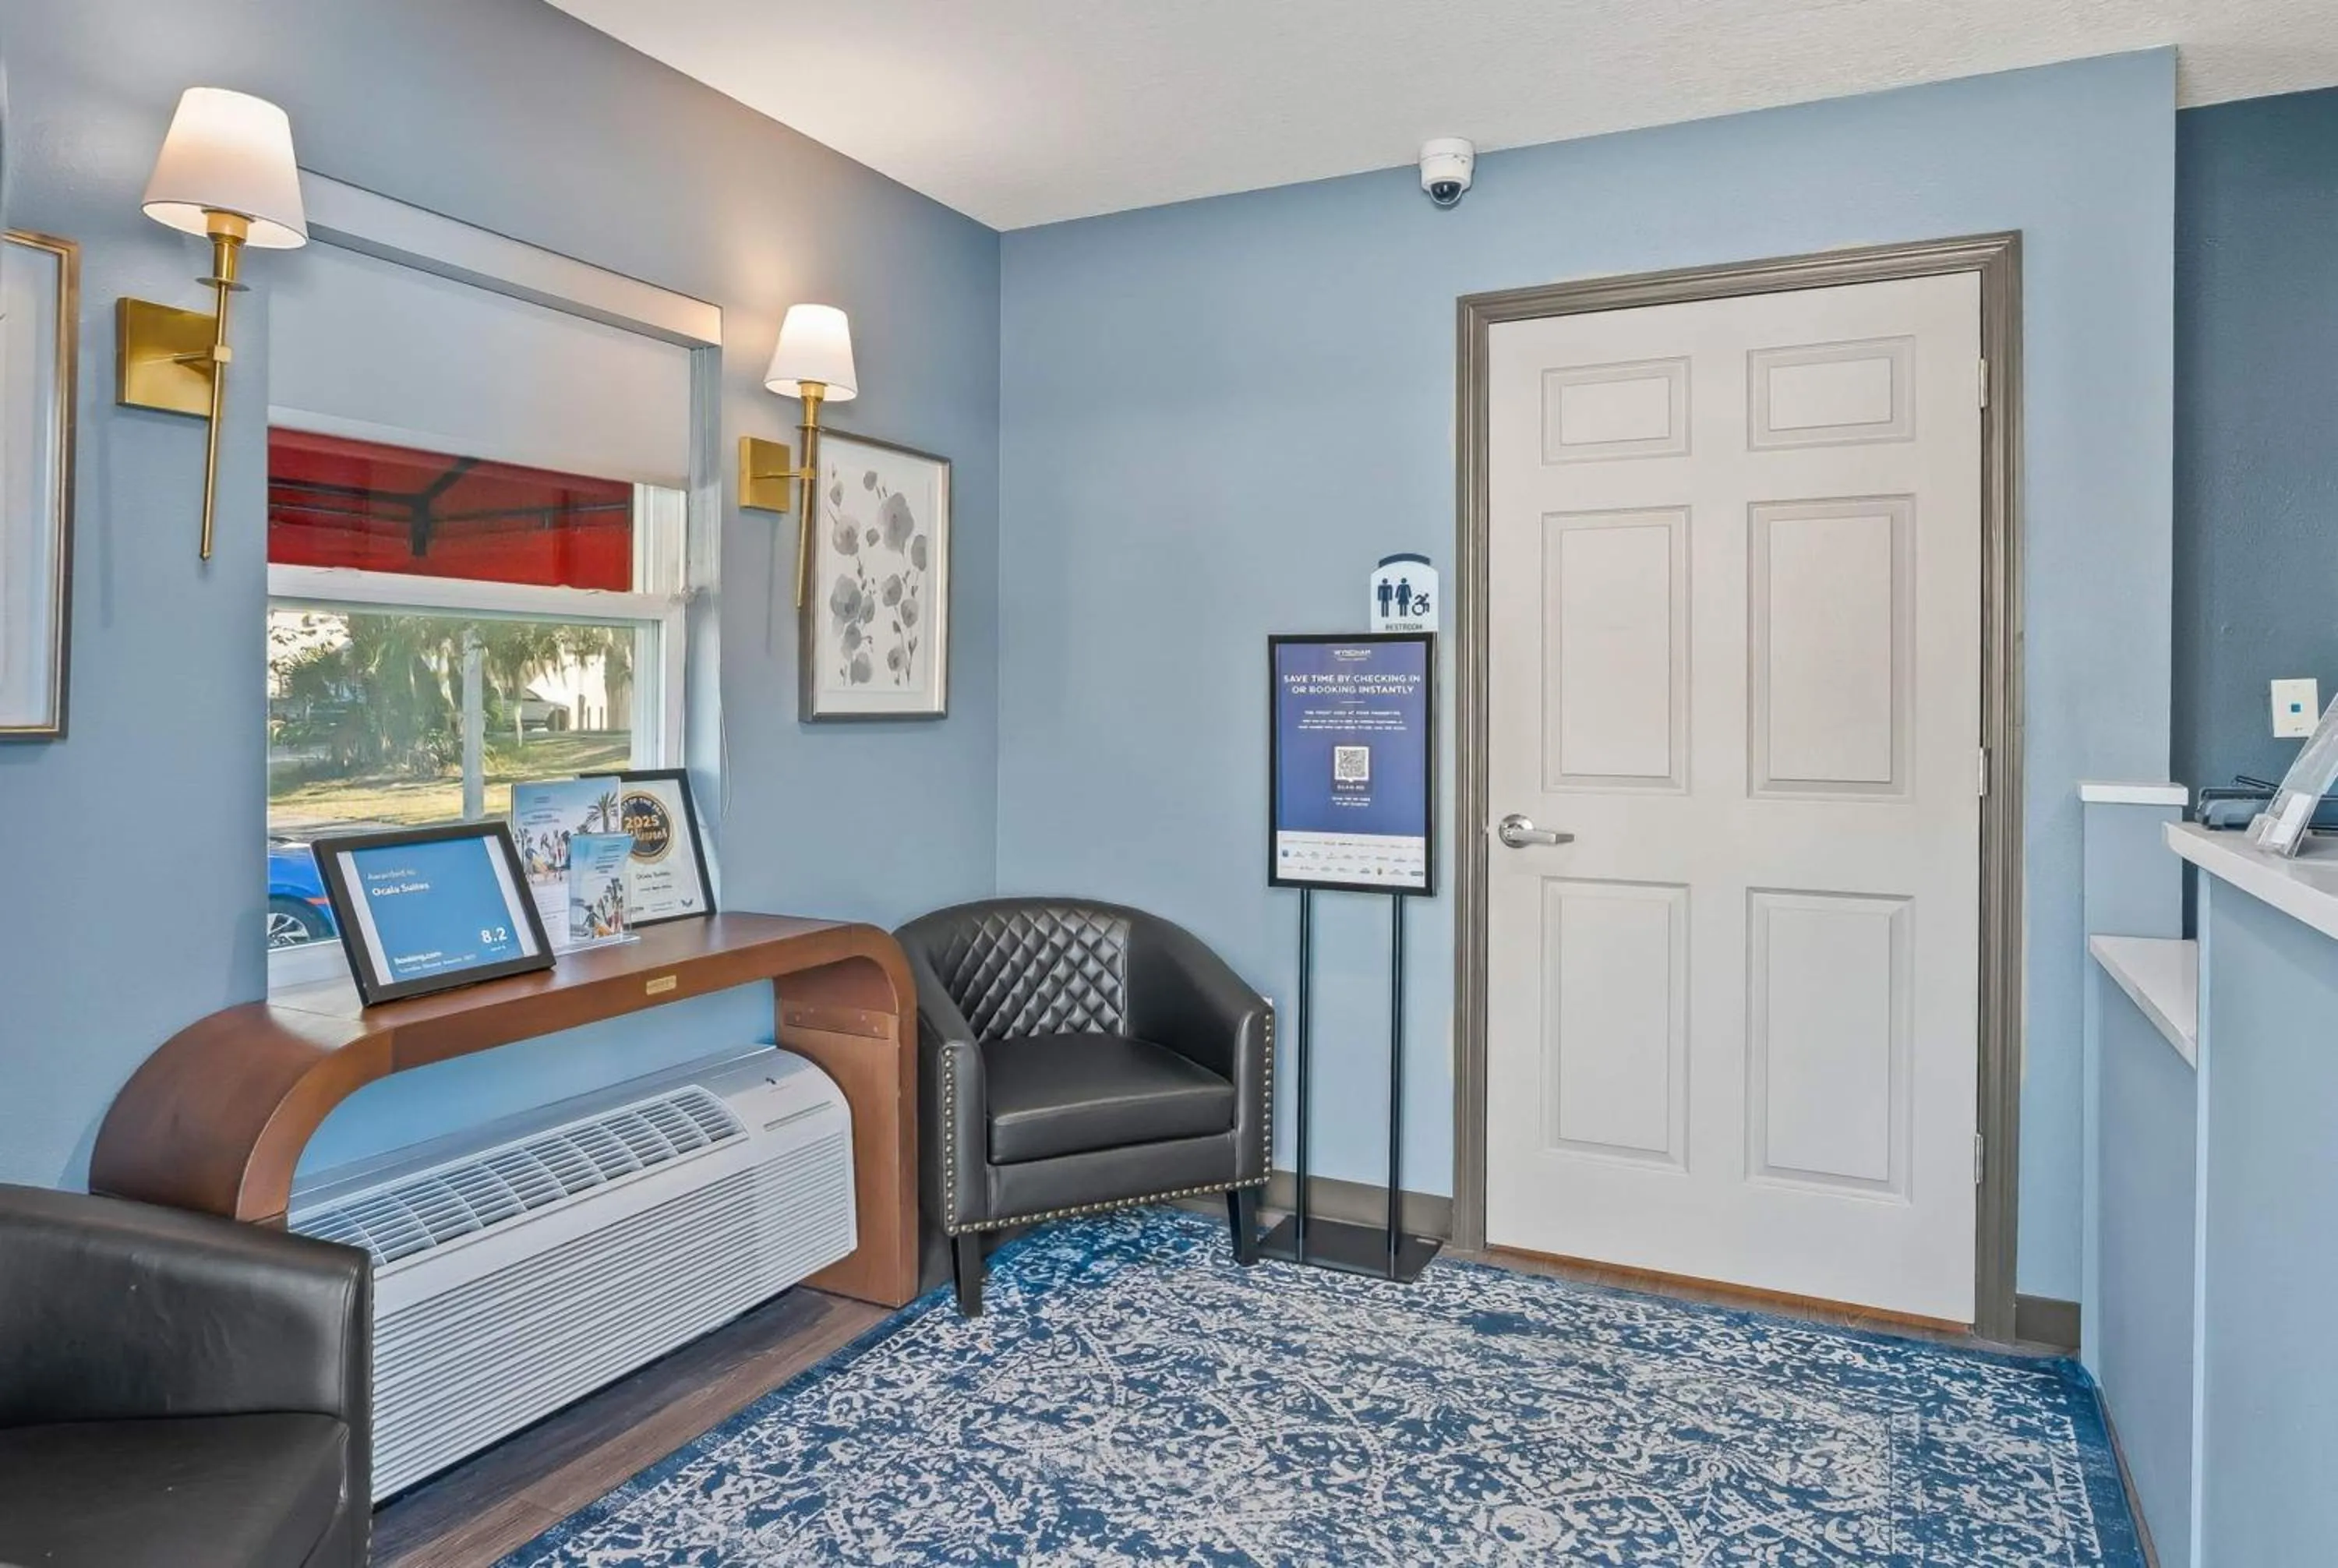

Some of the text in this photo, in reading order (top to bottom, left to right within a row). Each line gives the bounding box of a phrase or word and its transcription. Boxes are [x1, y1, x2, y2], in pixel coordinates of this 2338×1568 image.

[1284, 674, 1421, 683] SAVE TIME BY CHECKING IN
[1291, 685, 1414, 694] OR BOOKING INSTANTLY
[624, 814, 660, 829] 2025
[372, 885, 400, 895] Ocala
[480, 927, 507, 944] 8.2
